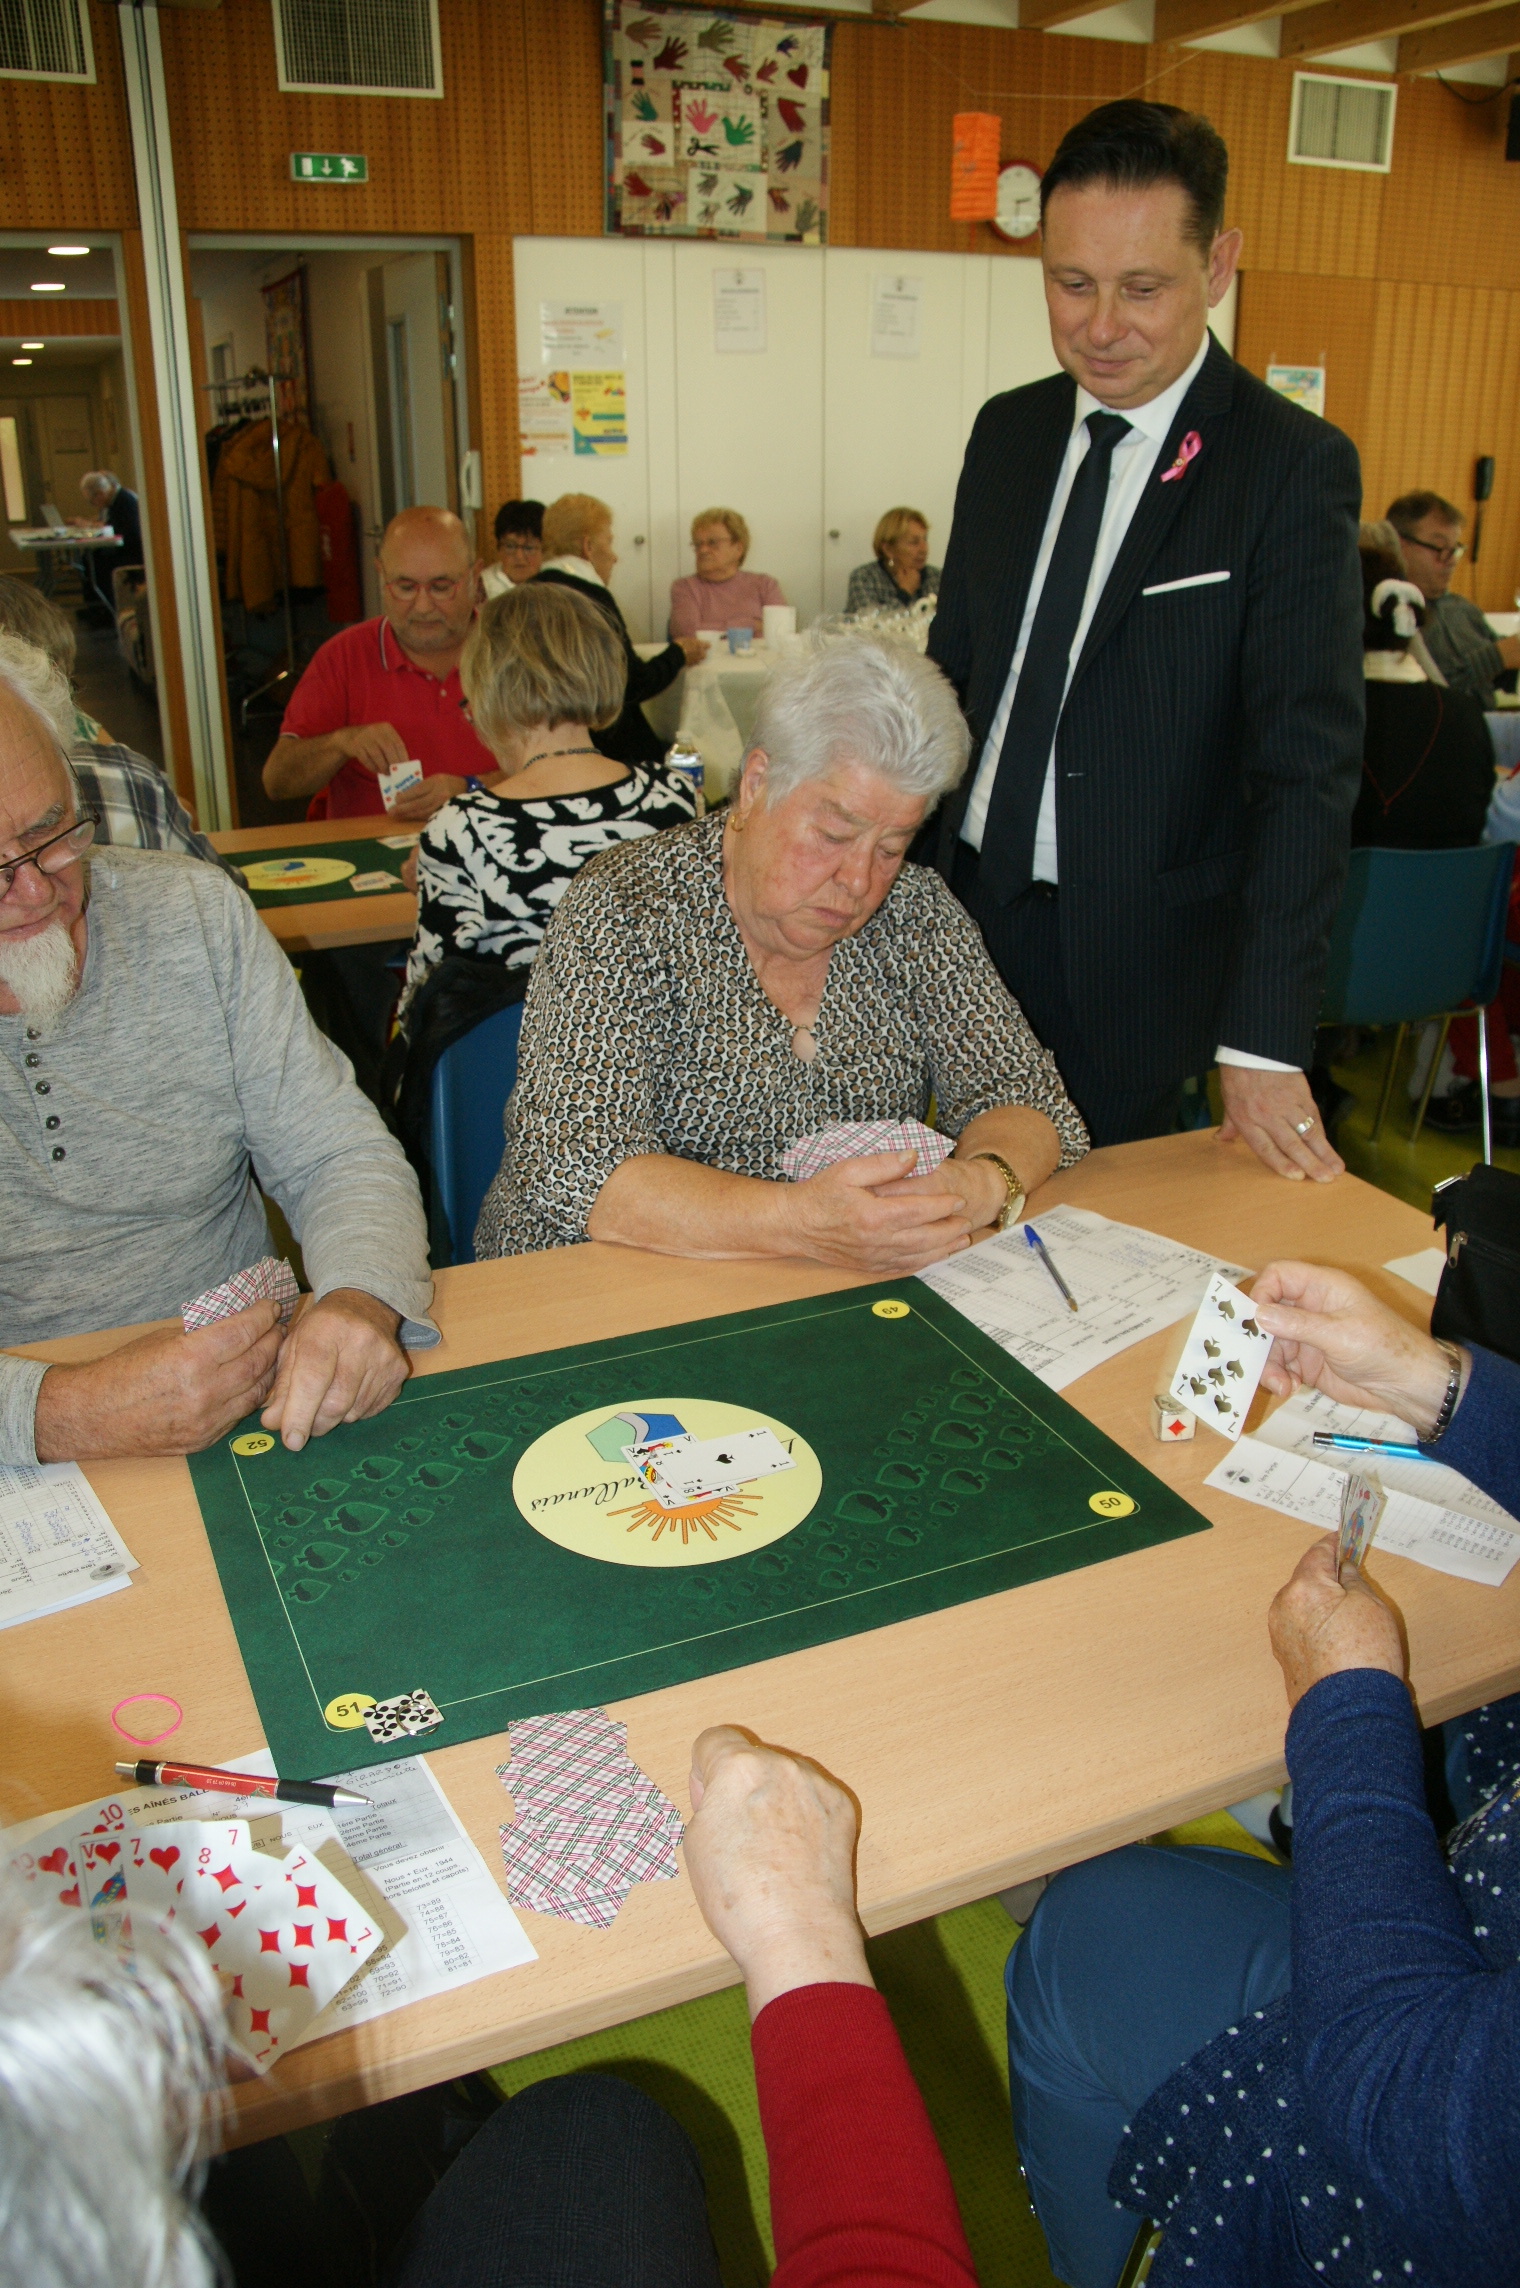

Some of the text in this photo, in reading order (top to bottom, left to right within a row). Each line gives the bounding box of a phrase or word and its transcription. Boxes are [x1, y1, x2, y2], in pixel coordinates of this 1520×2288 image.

[1215, 1280, 1223, 1292] 7
[1176, 1384, 1185, 1395] 7
[1228, 1421, 1236, 1433] 7
[246, 1439, 267, 1450] 52
[1099, 1497, 1121, 1509] 50
[337, 1701, 360, 1717] 51
[143, 1797, 178, 1810] AÎNÉS
[371, 1798, 397, 1811] Totaux
[100, 1803, 123, 1825] 10
[355, 1814, 378, 1825] Partie
[363, 1818, 385, 1829] Partie
[366, 1824, 388, 1835] Partie
[228, 1829, 238, 1845] 7
[269, 1832, 292, 1842] NOUS
[307, 1822, 325, 1831] EUX
[369, 1830, 392, 1842] Partie
[81, 1844, 96, 1858] V
[130, 1838, 141, 1855] 7
[353, 1842, 403, 1864] Total général
[198, 1847, 212, 1864] 8
[373, 1860, 395, 1872] Vous
[395, 1853, 418, 1866] devez
[292, 1856, 307, 1870] 7
[384, 1872, 406, 1885] Nous
[413, 1865, 429, 1875] Eux
[435, 1857, 454, 1868] 1944
[383, 1866, 469, 1901] hors belotes et capots)
[385, 1880, 411, 1893] (Partie
[424, 1871, 435, 1880] 12
[357, 1927, 372, 1941] 7
[255, 2048, 271, 2063] 7
